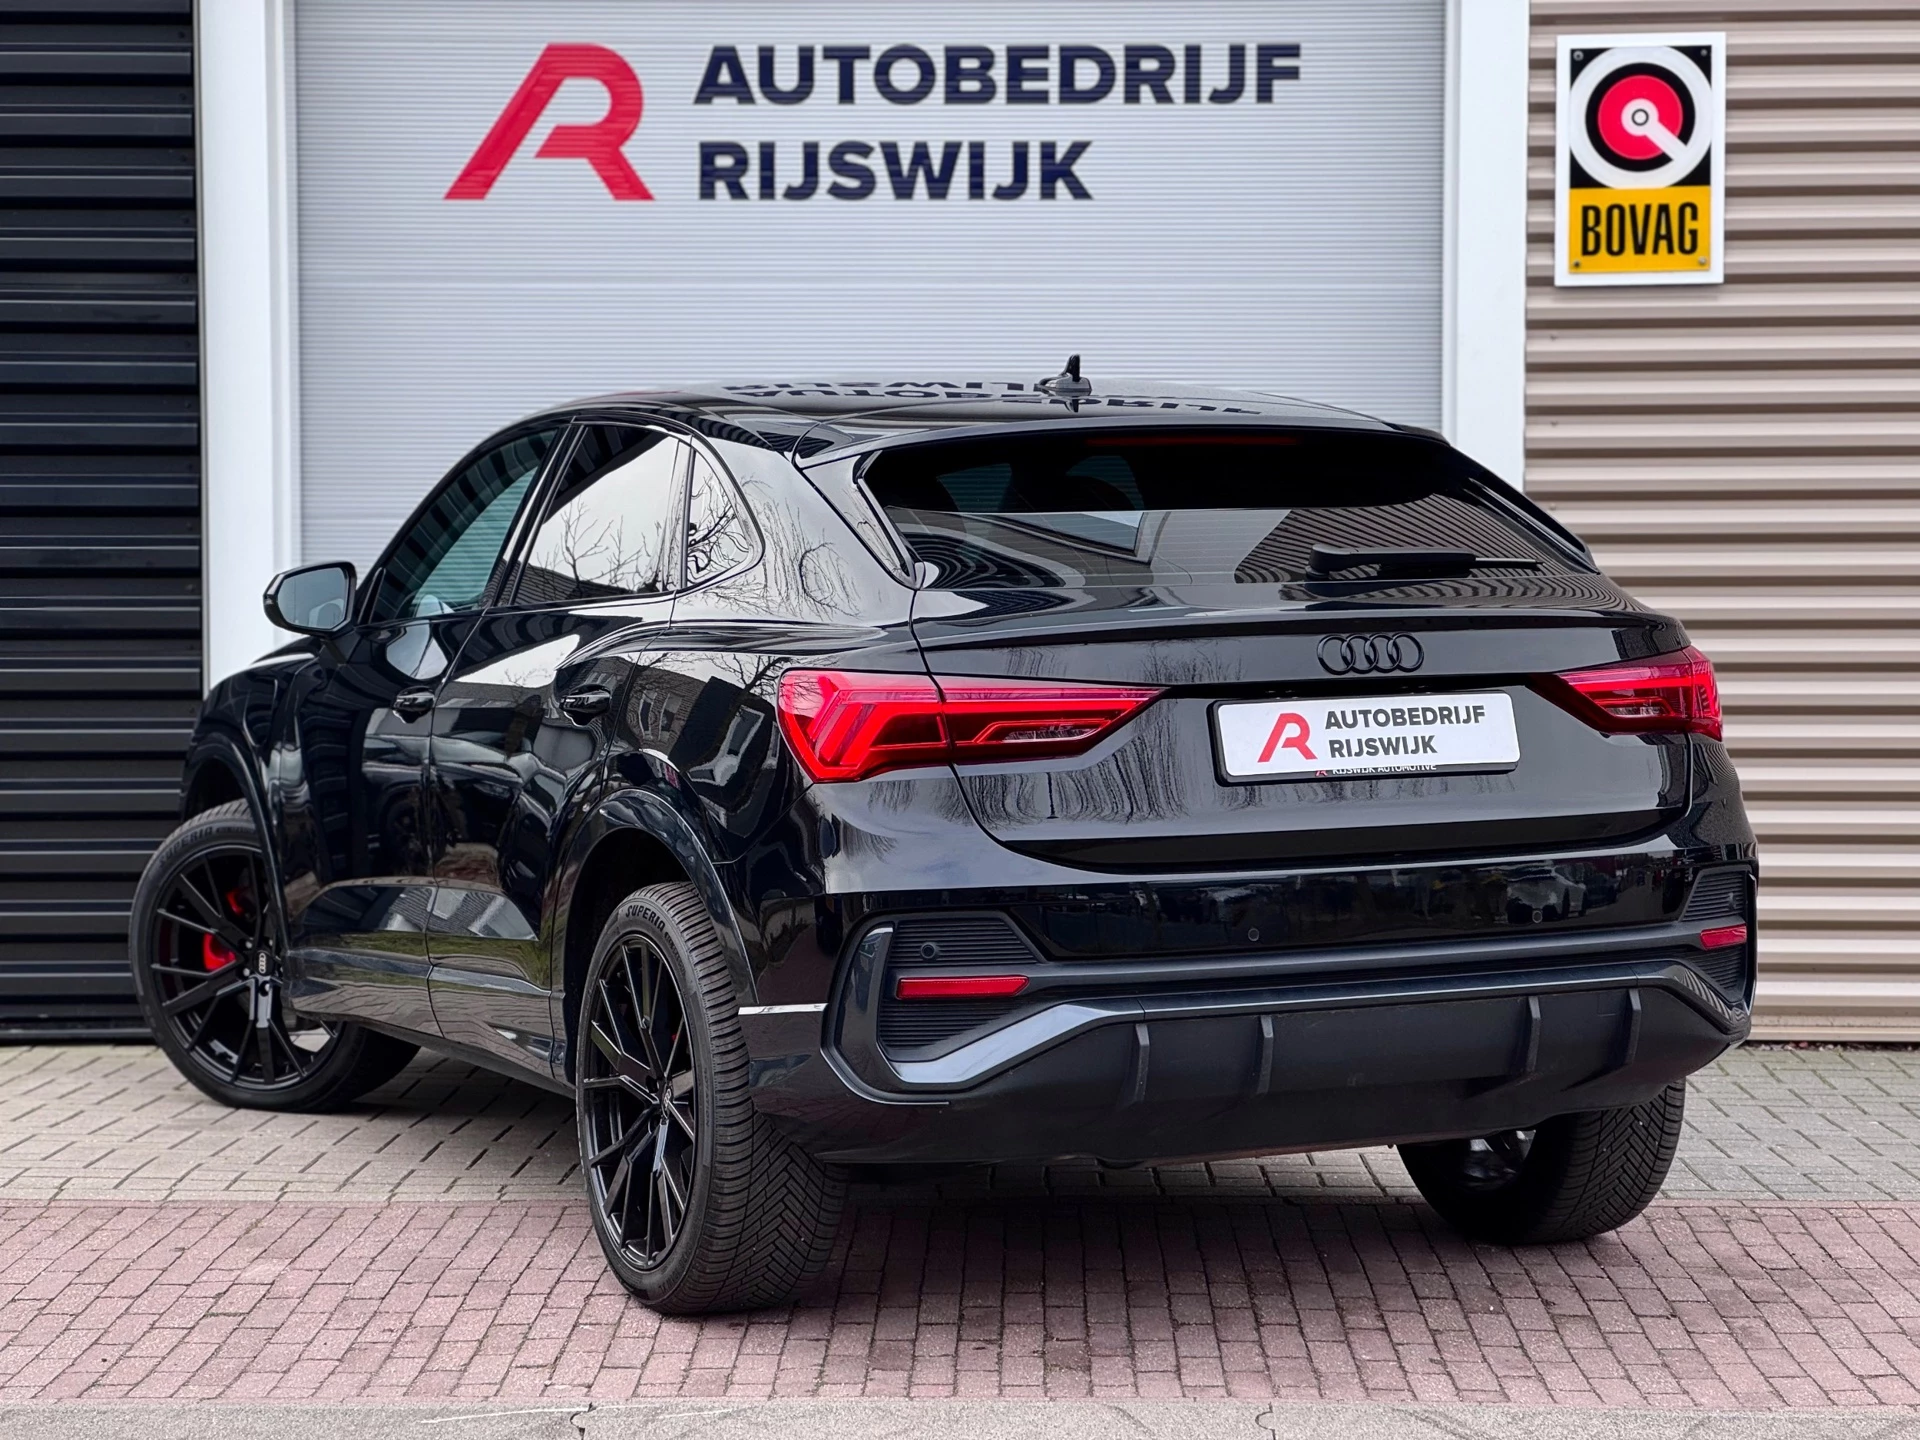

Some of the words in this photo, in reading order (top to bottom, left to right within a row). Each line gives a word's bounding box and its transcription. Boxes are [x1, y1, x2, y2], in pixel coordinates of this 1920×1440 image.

[694, 44, 1301, 105] AUTOBEDRIJF
[698, 140, 1094, 201] RIJSWIJK
[1581, 202, 1698, 256] BOVAG
[1325, 705, 1485, 730] AUTOBEDRIJF
[1328, 735, 1438, 759] RIJSWIJK
[625, 904, 666, 933] SUPERIA
